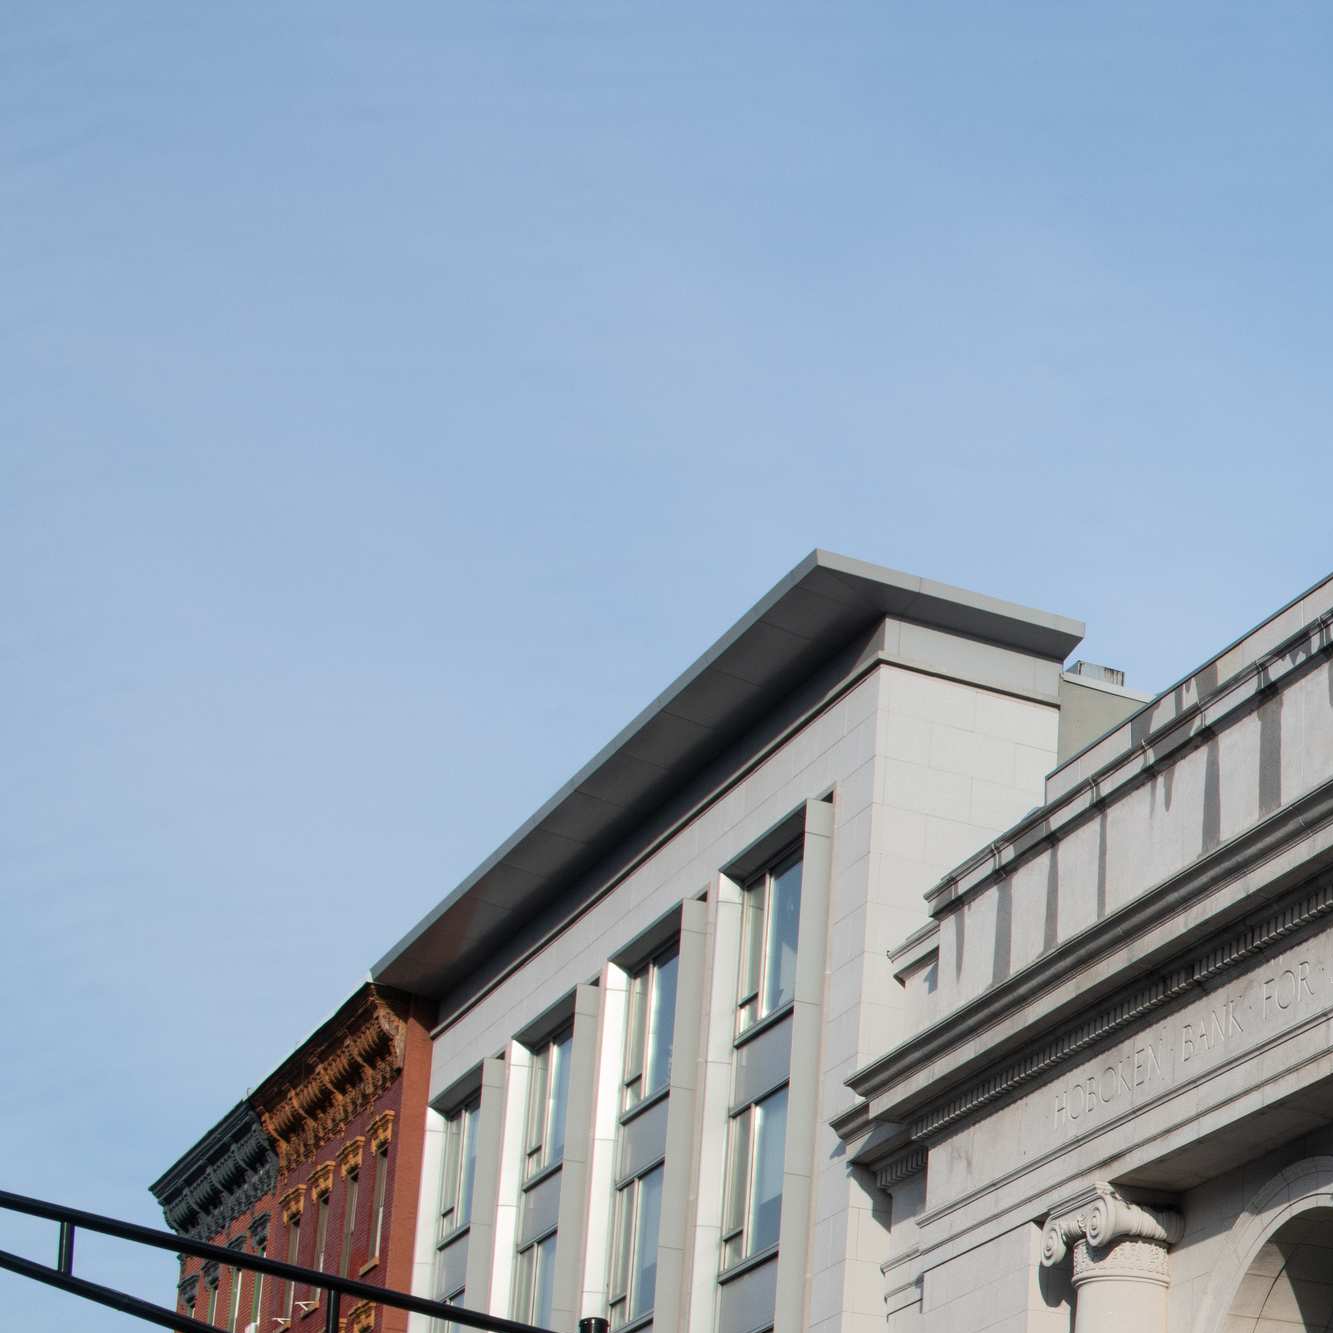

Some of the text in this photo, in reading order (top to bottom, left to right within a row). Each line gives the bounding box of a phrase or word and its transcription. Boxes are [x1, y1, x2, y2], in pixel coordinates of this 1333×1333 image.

[1053, 1038, 1161, 1130] HOBOKEN
[1182, 999, 1244, 1063] BANK
[1263, 960, 1315, 1021] FOR
